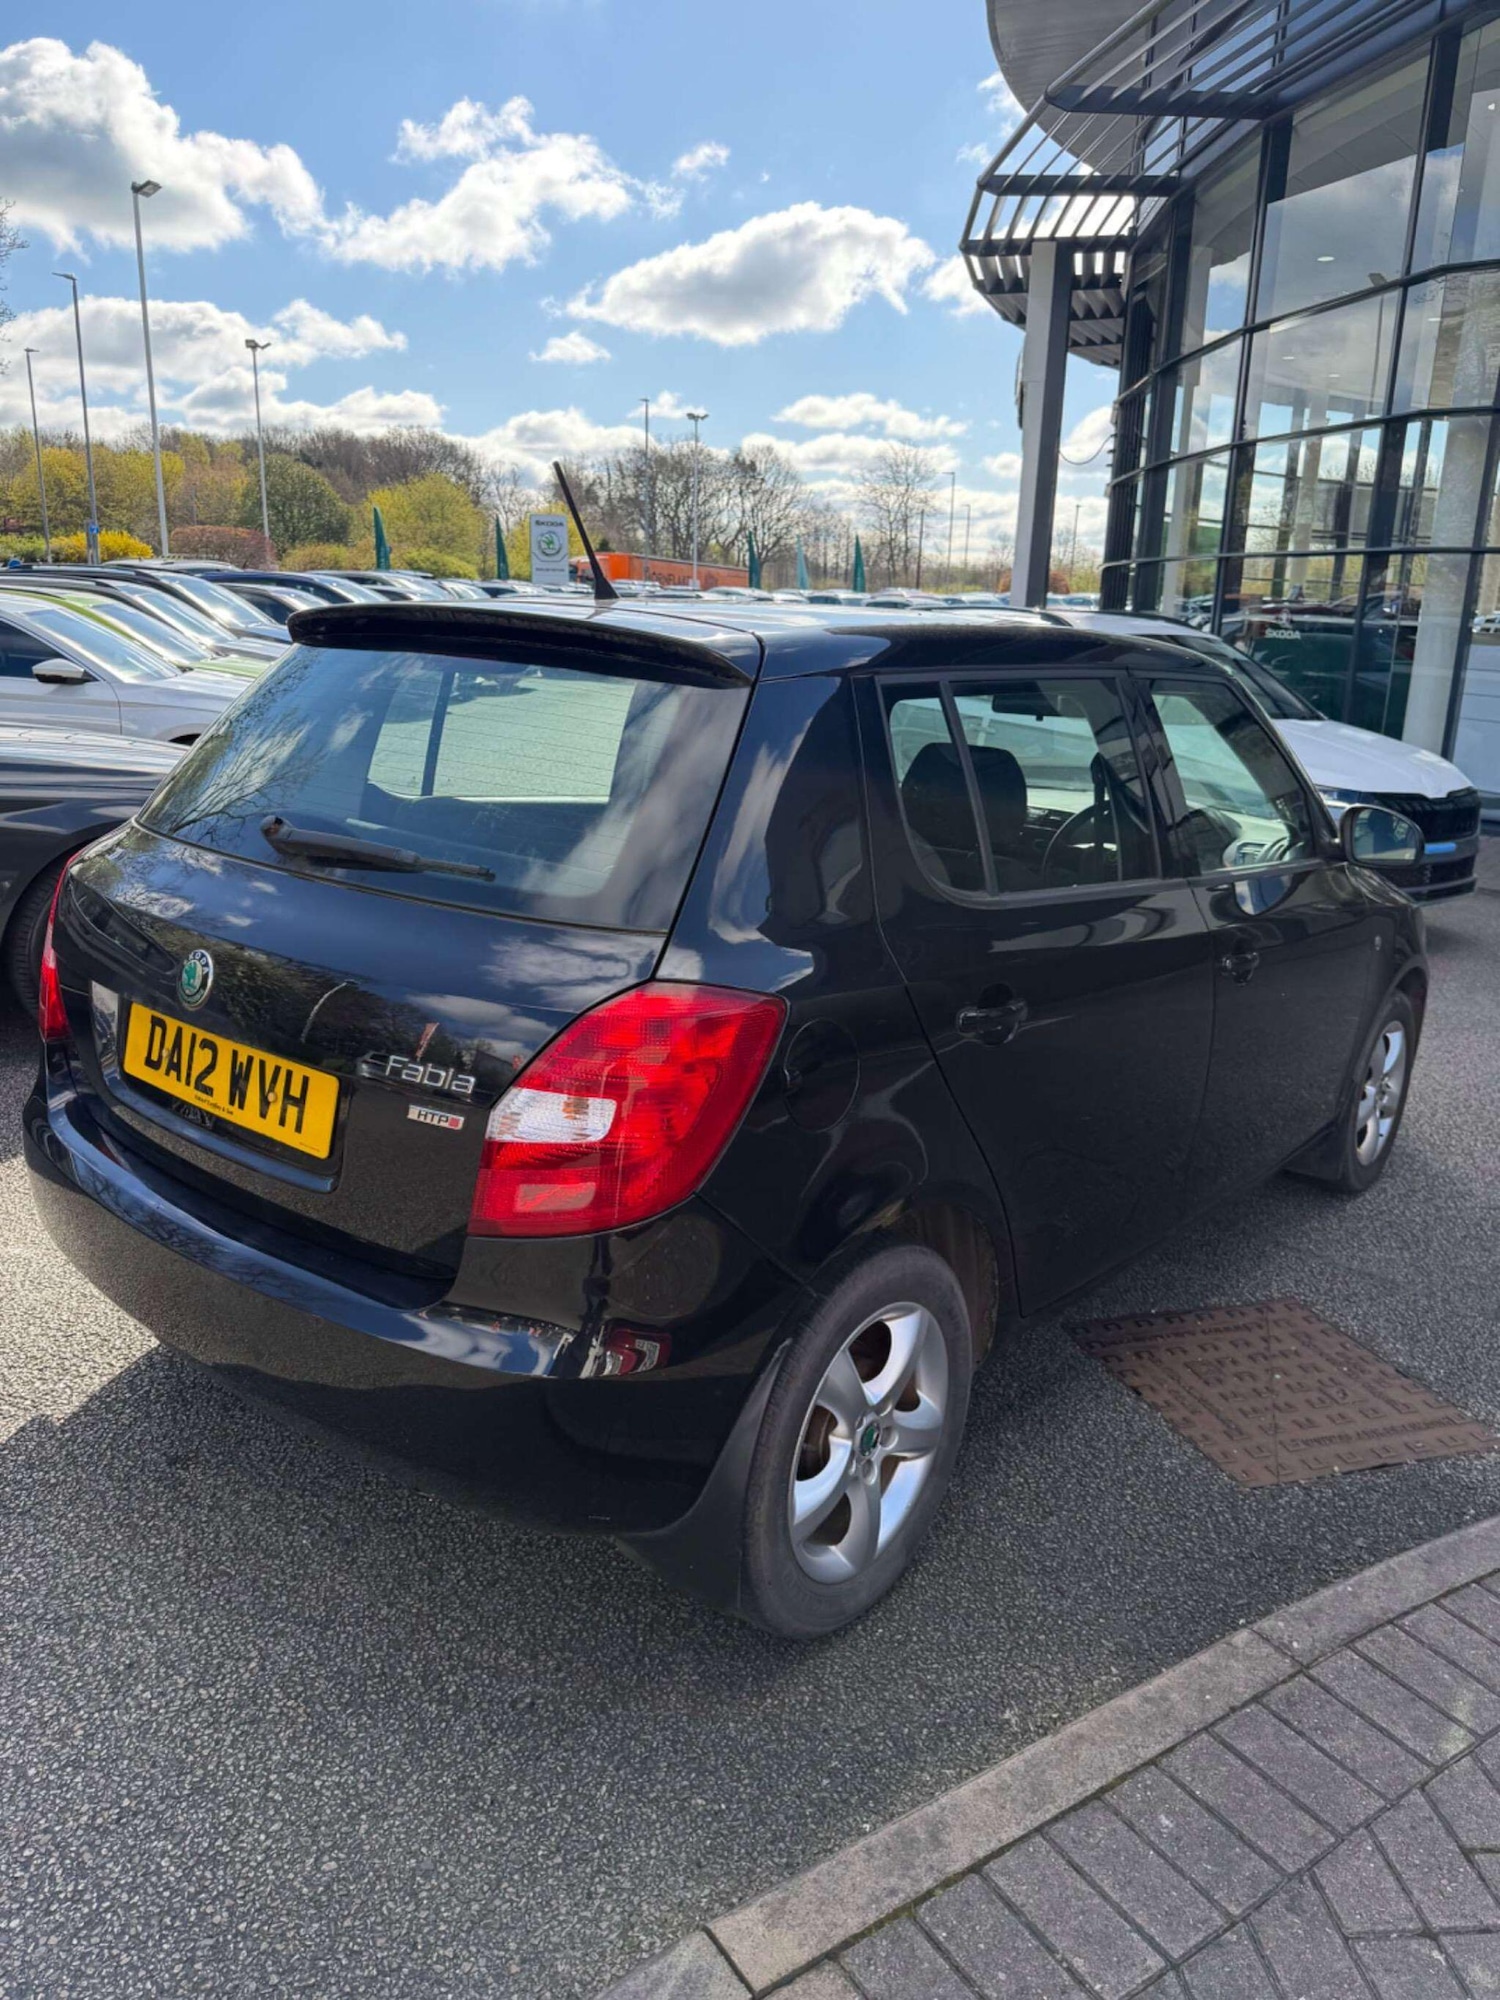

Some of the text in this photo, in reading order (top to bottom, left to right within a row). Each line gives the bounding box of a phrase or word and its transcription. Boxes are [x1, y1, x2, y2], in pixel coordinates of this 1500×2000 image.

[144, 1015, 310, 1134] DA12 WVH
[385, 1054, 476, 1094] Fabia
